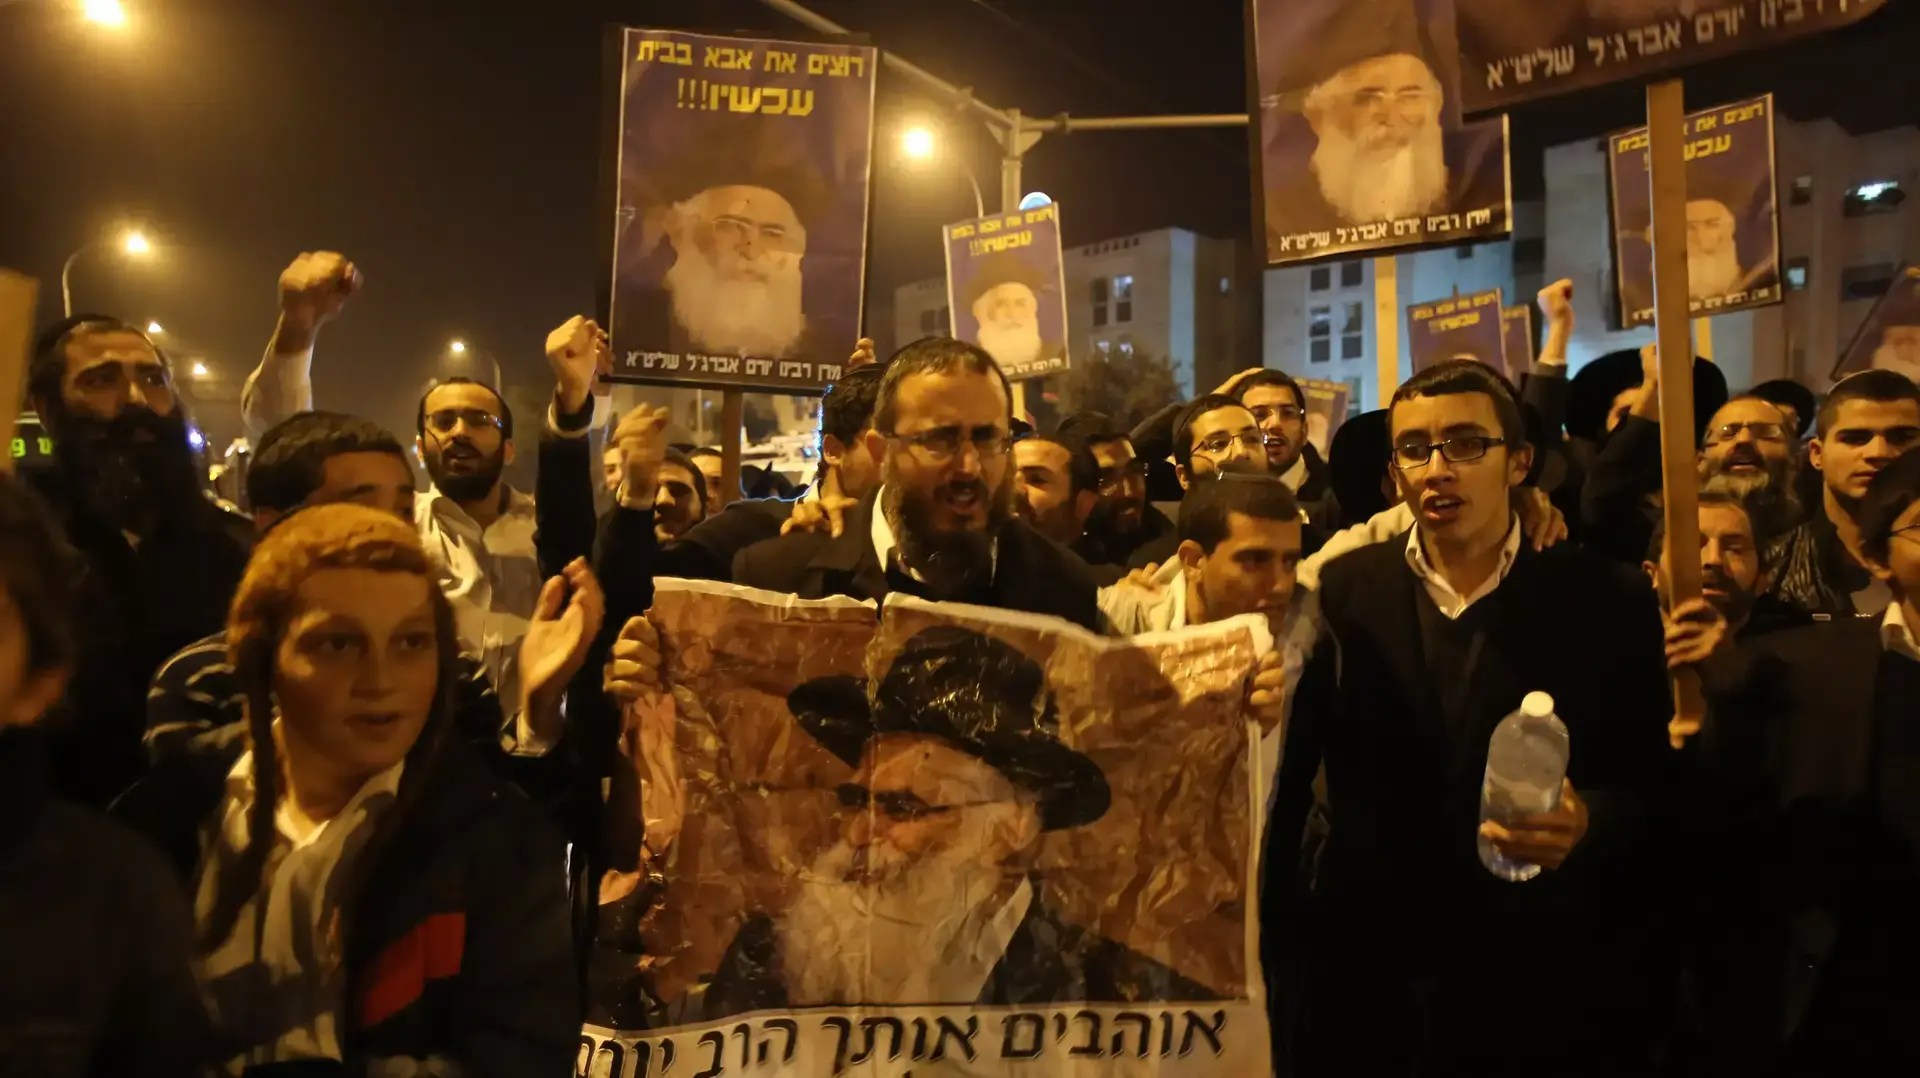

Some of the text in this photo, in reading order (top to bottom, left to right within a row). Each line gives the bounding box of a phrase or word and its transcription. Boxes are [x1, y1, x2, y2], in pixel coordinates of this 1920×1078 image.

[1693, 10, 1746, 43] יורם
[1588, 20, 1682, 67] אברג'ל
[637, 39, 865, 78] רוצים את אבא בבית
[677, 78, 815, 117] עכשיו!!!
[1695, 115, 1718, 133] את
[1724, 102, 1764, 125] רוצים
[1393, 217, 1421, 237] יורם
[1426, 213, 1460, 232] רבינו
[1466, 208, 1491, 230] מרן
[1336, 222, 1388, 244] אברג'ל
[686, 353, 740, 375] אברג'ל
[745, 358, 774, 376] יורם
[779, 359, 811, 379] רבינו
[817, 363, 843, 381] מרן
[819, 1013, 979, 1078] אותך
[1000, 1009, 1225, 1061] אוהבים
